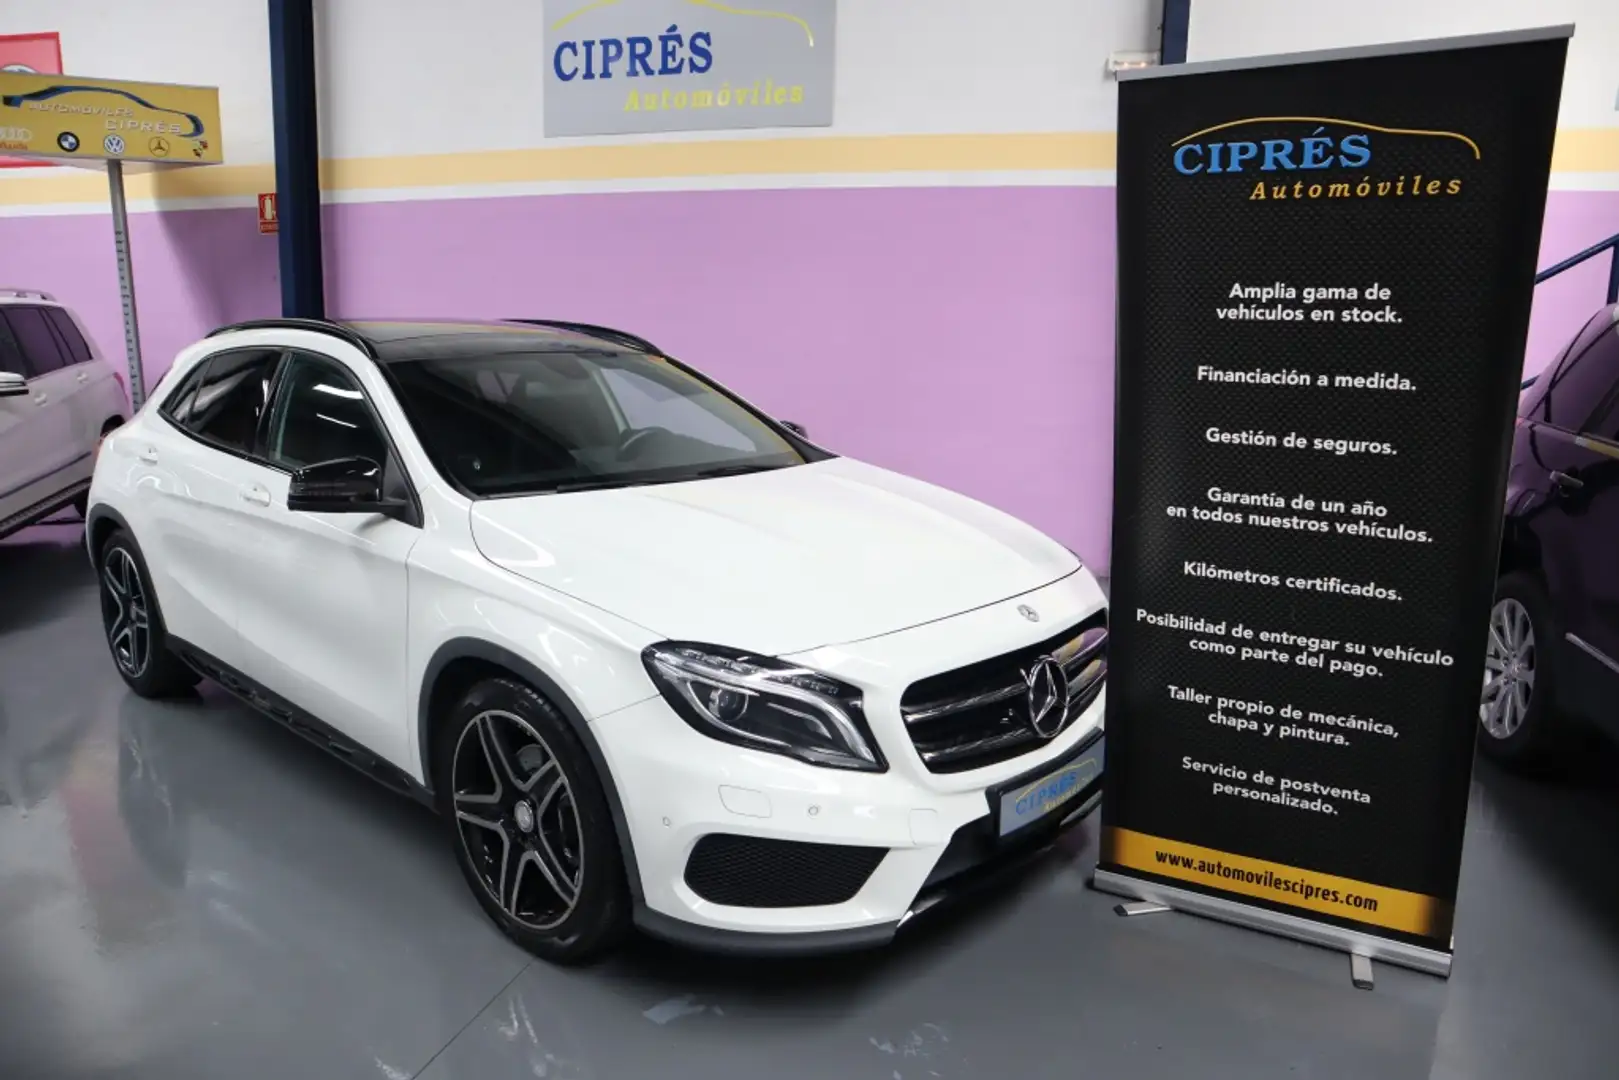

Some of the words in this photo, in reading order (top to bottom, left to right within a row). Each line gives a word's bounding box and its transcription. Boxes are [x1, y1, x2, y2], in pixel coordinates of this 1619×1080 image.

[553, 24, 713, 82] CIPRÉS
[622, 80, 805, 112] Automóviles
[1173, 126, 1372, 176] CIPRÉS
[1249, 174, 1463, 201] Automóviles
[1229, 282, 1297, 303] Amplia
[1303, 286, 1358, 303] gama
[1365, 282, 1392, 301] de
[1216, 303, 1305, 321] vehículos
[1311, 309, 1335, 322] en
[1342, 305, 1403, 323] stock.
[1197, 365, 1311, 387] Financiación
[1316, 374, 1329, 387] a
[1334, 372, 1417, 391] medida.
[1205, 427, 1277, 447] Gestión
[1282, 432, 1308, 449] de
[1313, 438, 1398, 456] seguros.
[1207, 486, 1286, 509] Garantía
[1291, 494, 1315, 511] de
[1321, 501, 1345, 514] un
[1350, 500, 1388, 518] año
[1166, 505, 1187, 519] en
[1192, 504, 1243, 524] todos
[1248, 513, 1330, 533] nuestros
[1334, 519, 1433, 544] vehículos.
[1184, 561, 1280, 587] Kilómetros
[1285, 576, 1402, 602] certificados.
[1136, 608, 1227, 636] Posibilidad
[1231, 623, 1255, 640] de
[1259, 630, 1341, 652] entregar
[1345, 641, 1366, 656] su
[1372, 644, 1454, 667] vehículo
[1189, 639, 1236, 656] como
[1241, 646, 1290, 664] parte
[1295, 651, 1324, 669] del
[1329, 658, 1384, 679] pago.
[1167, 684, 1212, 705] Taller
[1217, 694, 1274, 716] propio
[1279, 703, 1303, 720] de
[1308, 711, 1399, 739] mecánica,
[1208, 708, 1259, 732] chapa
[1263, 722, 1275, 737] y
[1279, 721, 1350, 747] pintura.
[1182, 756, 1248, 781] Servicio
[1252, 769, 1275, 786] de
[1279, 776, 1371, 804] postventa
[1212, 779, 1339, 816] personalizado.
[1154, 850, 1378, 913] www.automovilescipres.com
